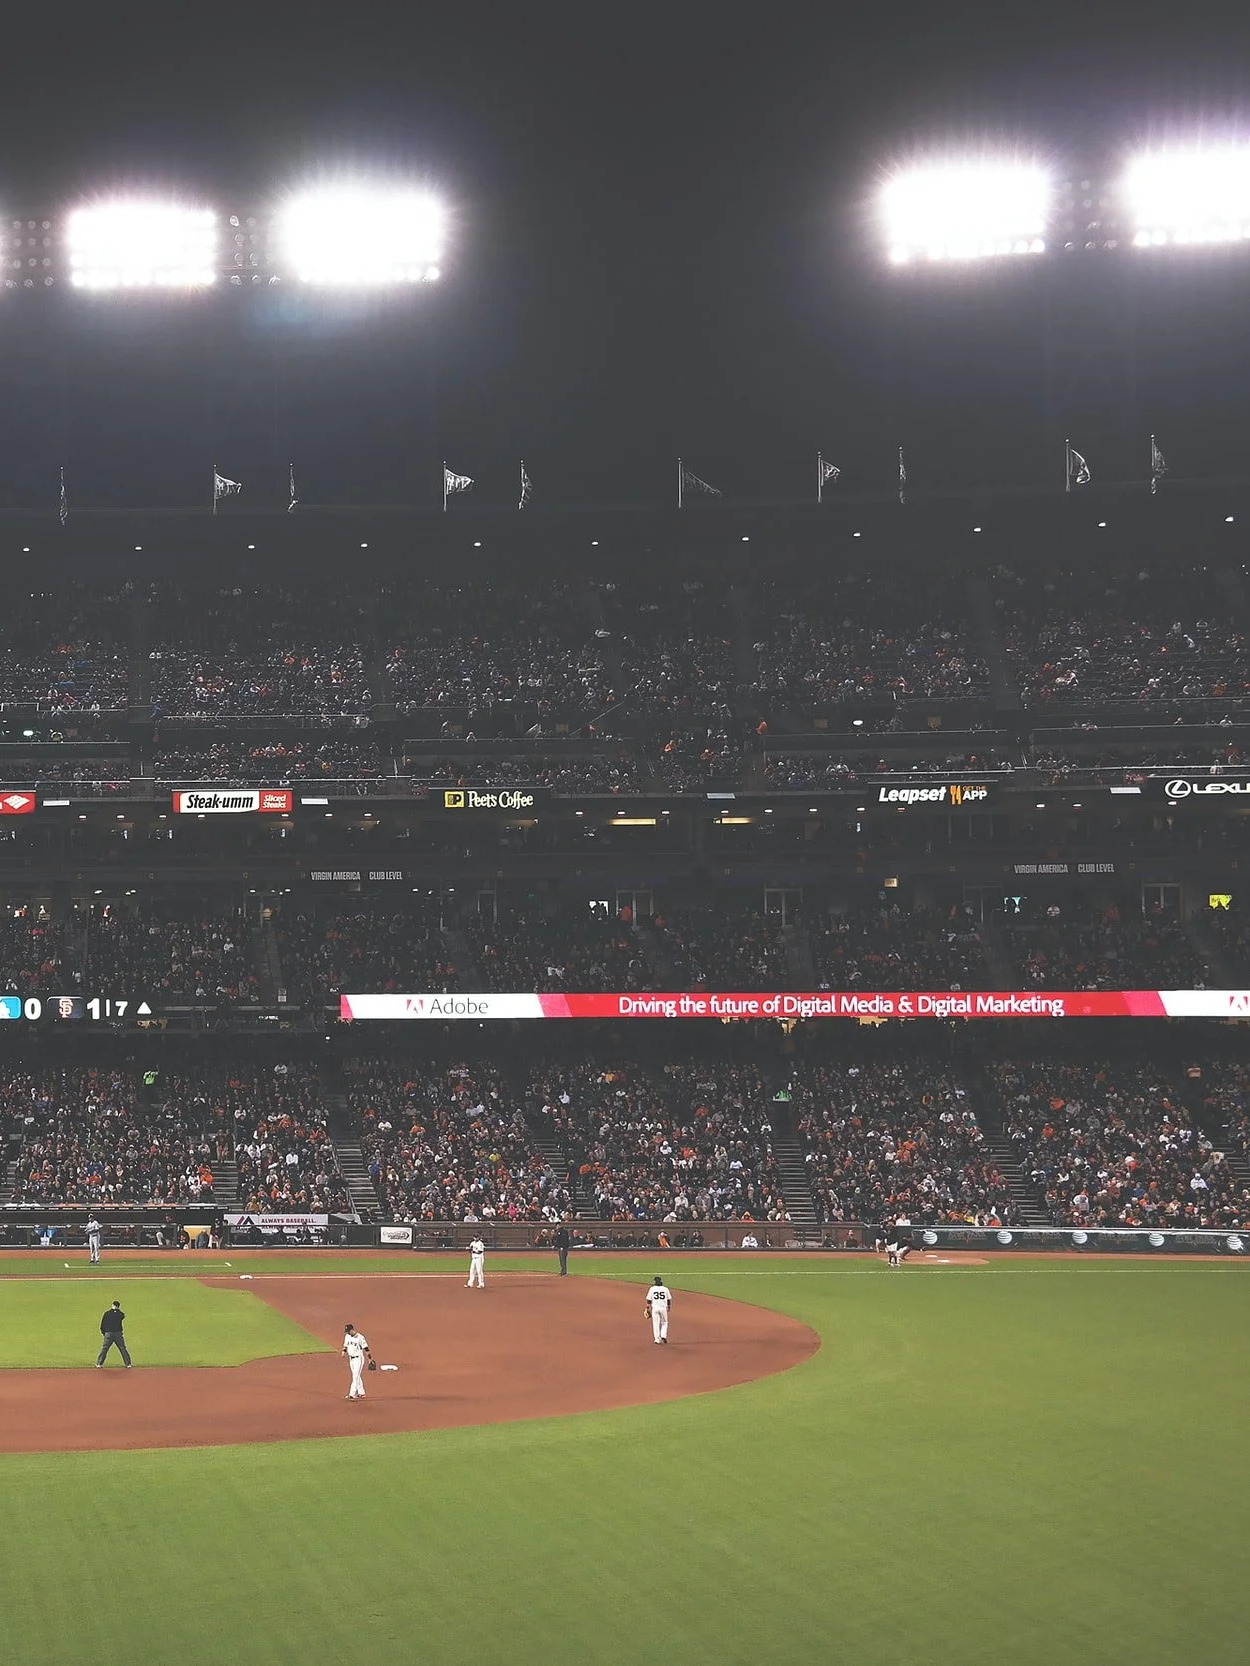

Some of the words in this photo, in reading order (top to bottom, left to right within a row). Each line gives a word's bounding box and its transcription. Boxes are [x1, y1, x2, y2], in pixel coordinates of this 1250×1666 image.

[186, 794, 254, 809] Steak-umm
[498, 790, 534, 809] Coffee
[878, 786, 947, 804] Leapset
[962, 790, 988, 800] APP
[310, 871, 333, 881] VIRGIN
[332, 871, 361, 881] AMERICA
[369, 871, 385, 880] CLUB
[385, 871, 403, 880] LEVEL
[1013, 864, 1038, 874] VIRGIN
[1038, 864, 1069, 874] AMERICA
[1077, 863, 1095, 873] CLUB
[1095, 863, 1115, 873] LEVEL
[24, 998, 42, 1020] 0
[86, 997, 100, 1020] 1
[115, 1000, 128, 1017] 7
[429, 998, 489, 1014] Adobe
[619, 996, 677, 1018] Driving
[679, 995, 707, 1014] the
[709, 995, 758, 1014] future
[762, 995, 781, 1014] of
[783, 995, 837, 1018] Digital
[840, 995, 894, 1013] Media
[898, 996, 913, 1013] &
[918, 995, 972, 1017] Digital
[976, 994, 1065, 1017] Marketing
[653, 1291, 666, 1300] 35
